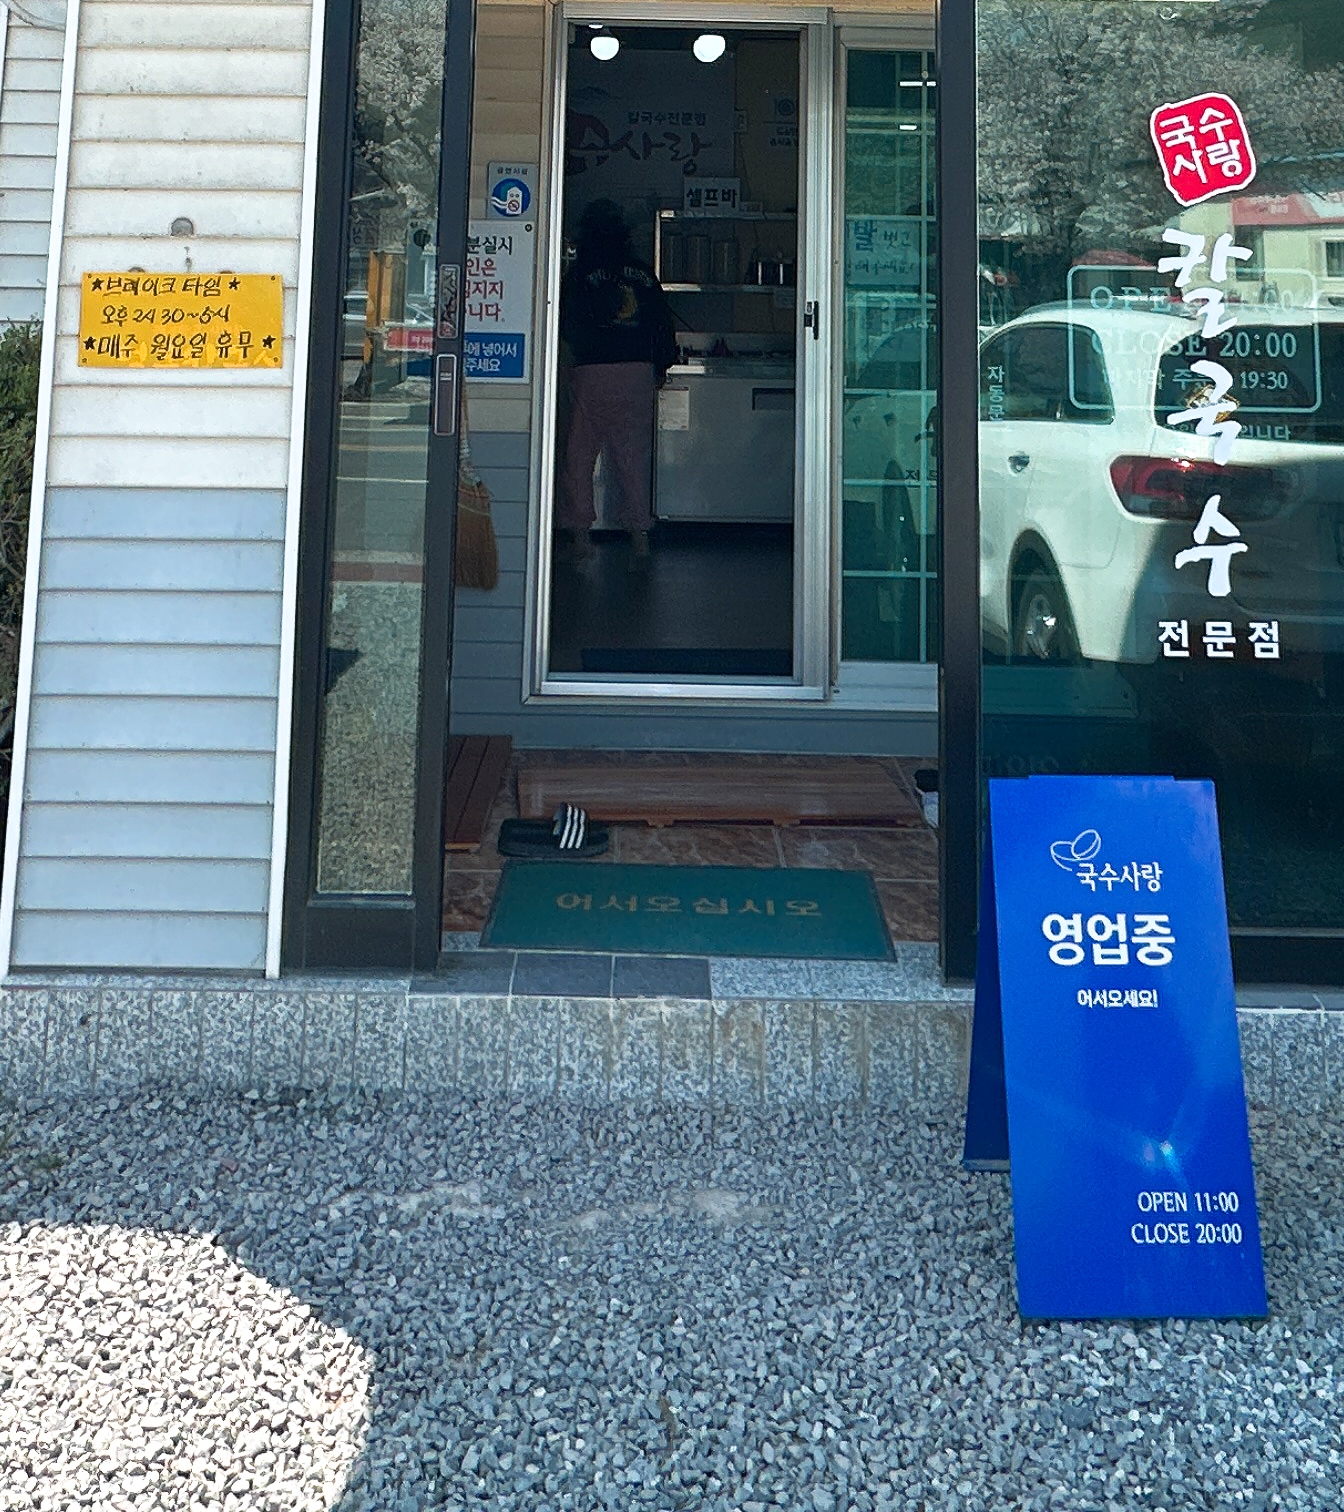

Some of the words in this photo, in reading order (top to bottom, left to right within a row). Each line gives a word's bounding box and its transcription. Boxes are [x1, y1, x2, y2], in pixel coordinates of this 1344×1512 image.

[1159, 108, 1236, 148] 국수
[687, 187, 738, 208] 셀프바
[182, 276, 221, 297] 타임
[101, 304, 128, 327] 오후
[465, 302, 506, 323] 니다.
[97, 334, 136, 359] 매주
[150, 332, 209, 361] 월요일
[215, 331, 255, 359] 휴무
[1219, 331, 1298, 358] 20:00
[1240, 370, 1289, 390] 19:30
[1157, 228, 1253, 597] 칼국수
[1157, 619, 1283, 660] 전문점
[1075, 861, 1163, 892] 국수사랑
[556, 893, 822, 918] 어서오십시오
[1042, 912, 1176, 967] 영업중
[1076, 988, 1158, 1009] 어서오세요!
[1137, 1191, 1189, 1214] OPEN
[1193, 1191, 1240, 1214] 11:00
[1130, 1222, 1191, 1245] CLOSE
[1194, 1222, 1243, 1245] 20:00
